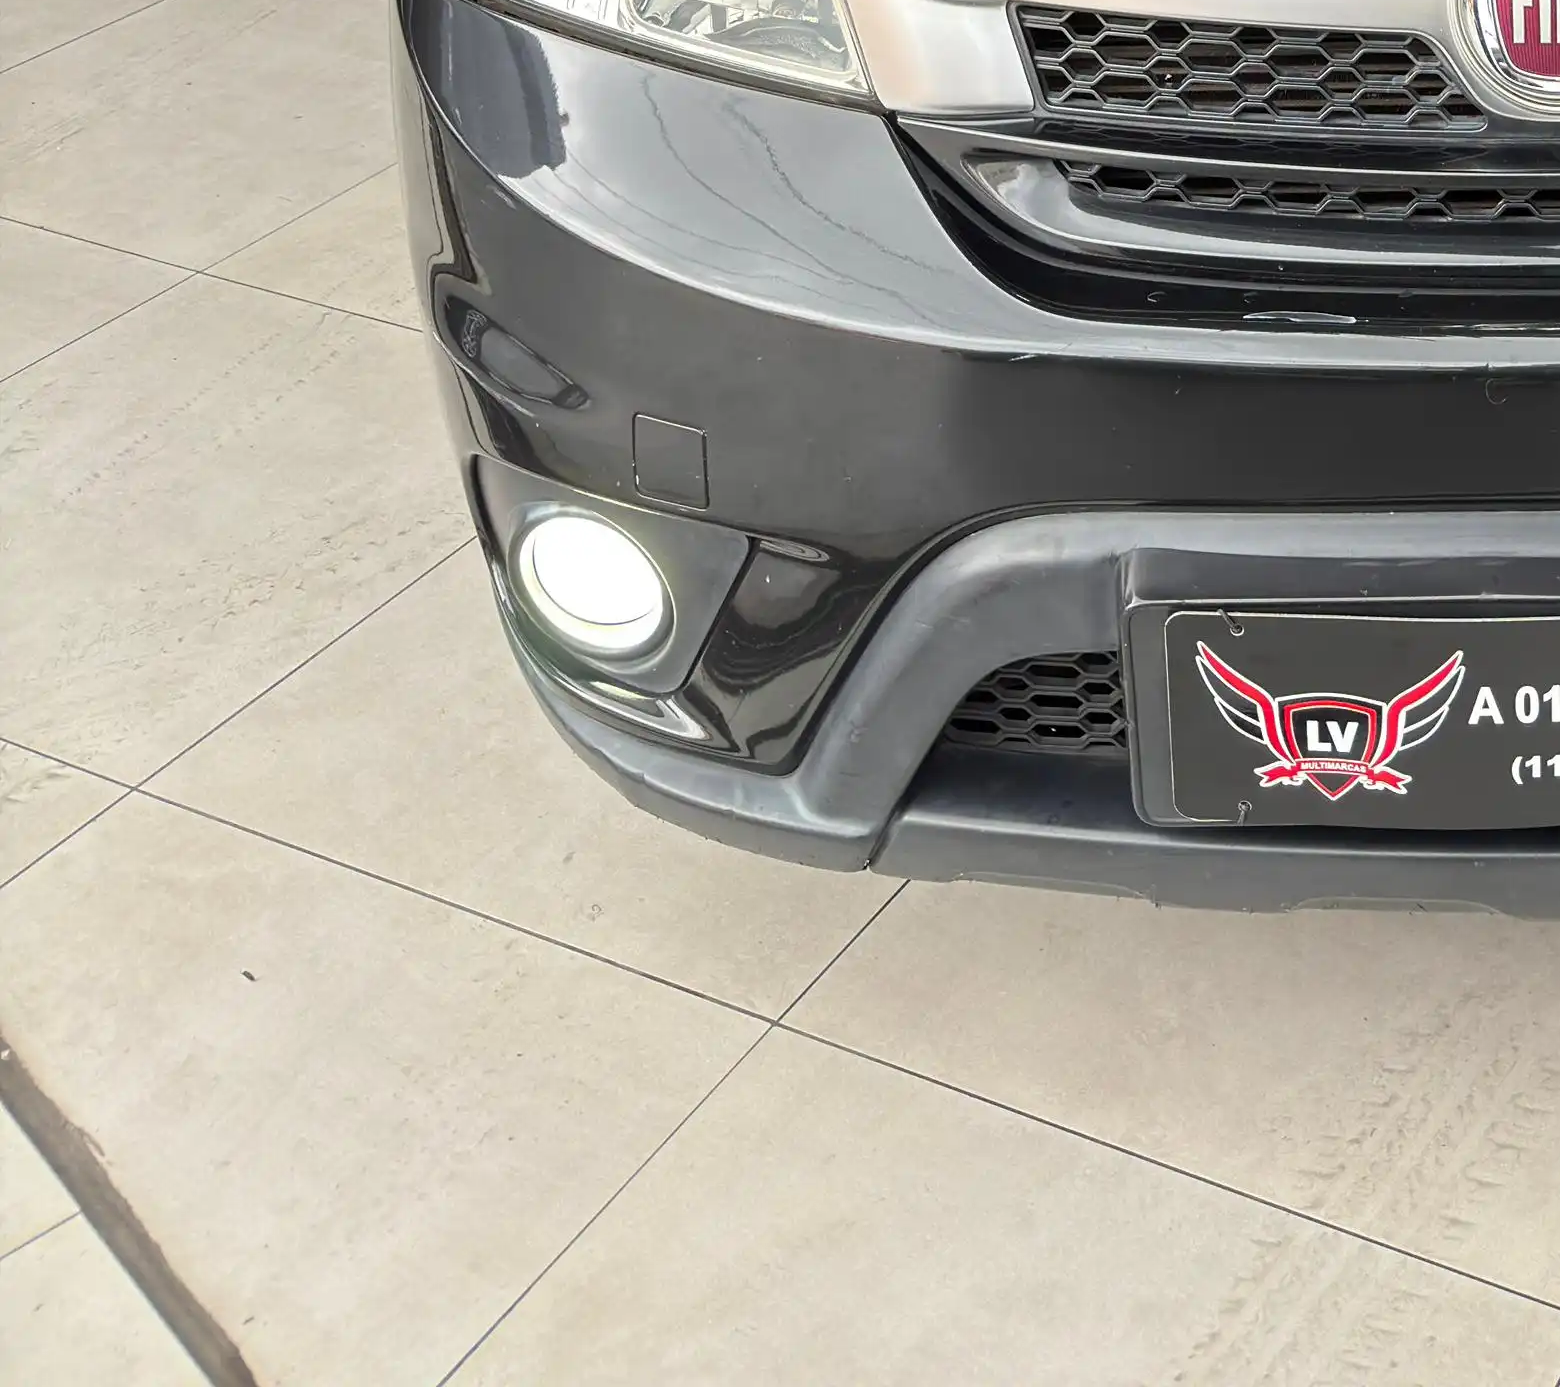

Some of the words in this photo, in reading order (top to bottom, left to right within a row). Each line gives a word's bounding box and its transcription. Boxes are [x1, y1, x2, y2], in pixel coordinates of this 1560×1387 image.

[1468, 686, 1505, 725] A
[1306, 720, 1359, 753] LV
[1300, 761, 1367, 774] MULTIMARCAS
